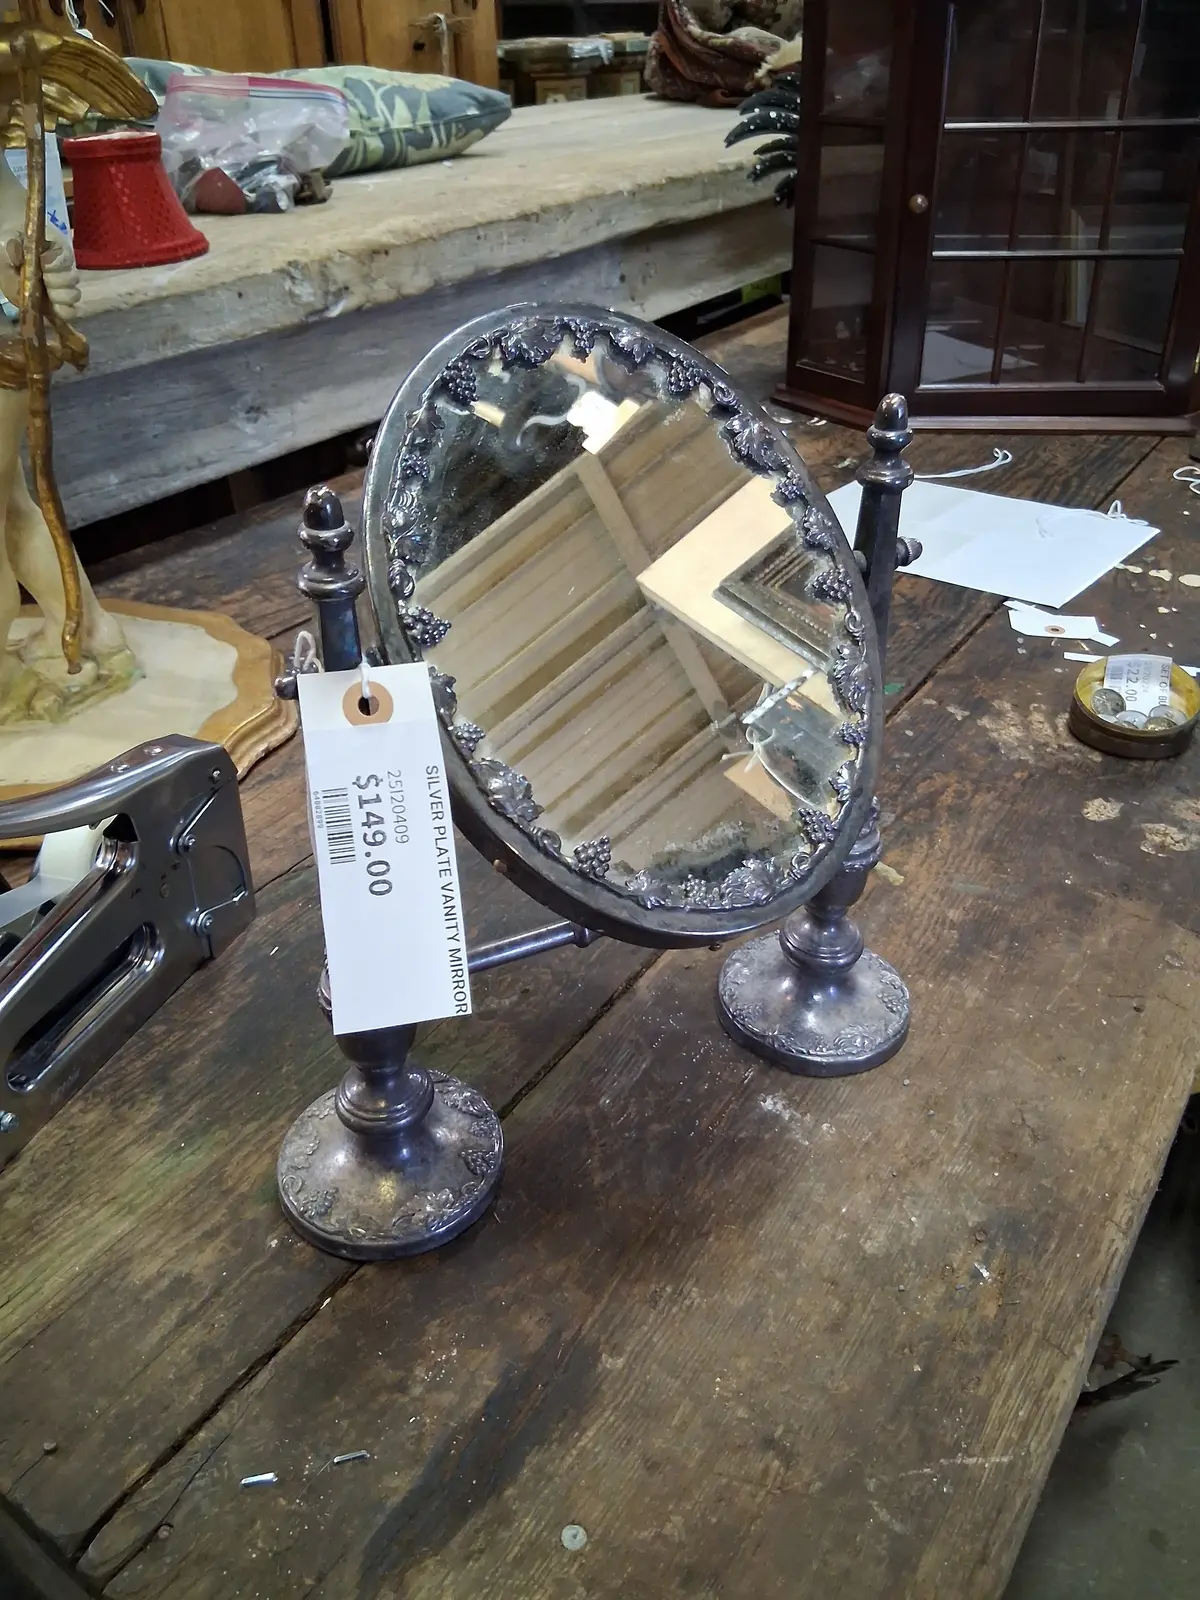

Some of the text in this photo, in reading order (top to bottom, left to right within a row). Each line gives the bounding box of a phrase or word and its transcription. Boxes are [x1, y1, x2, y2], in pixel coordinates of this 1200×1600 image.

[352, 774, 393, 896] $149.00
[426, 765, 468, 1015] SILVER PLATE VANITY MIRROR
